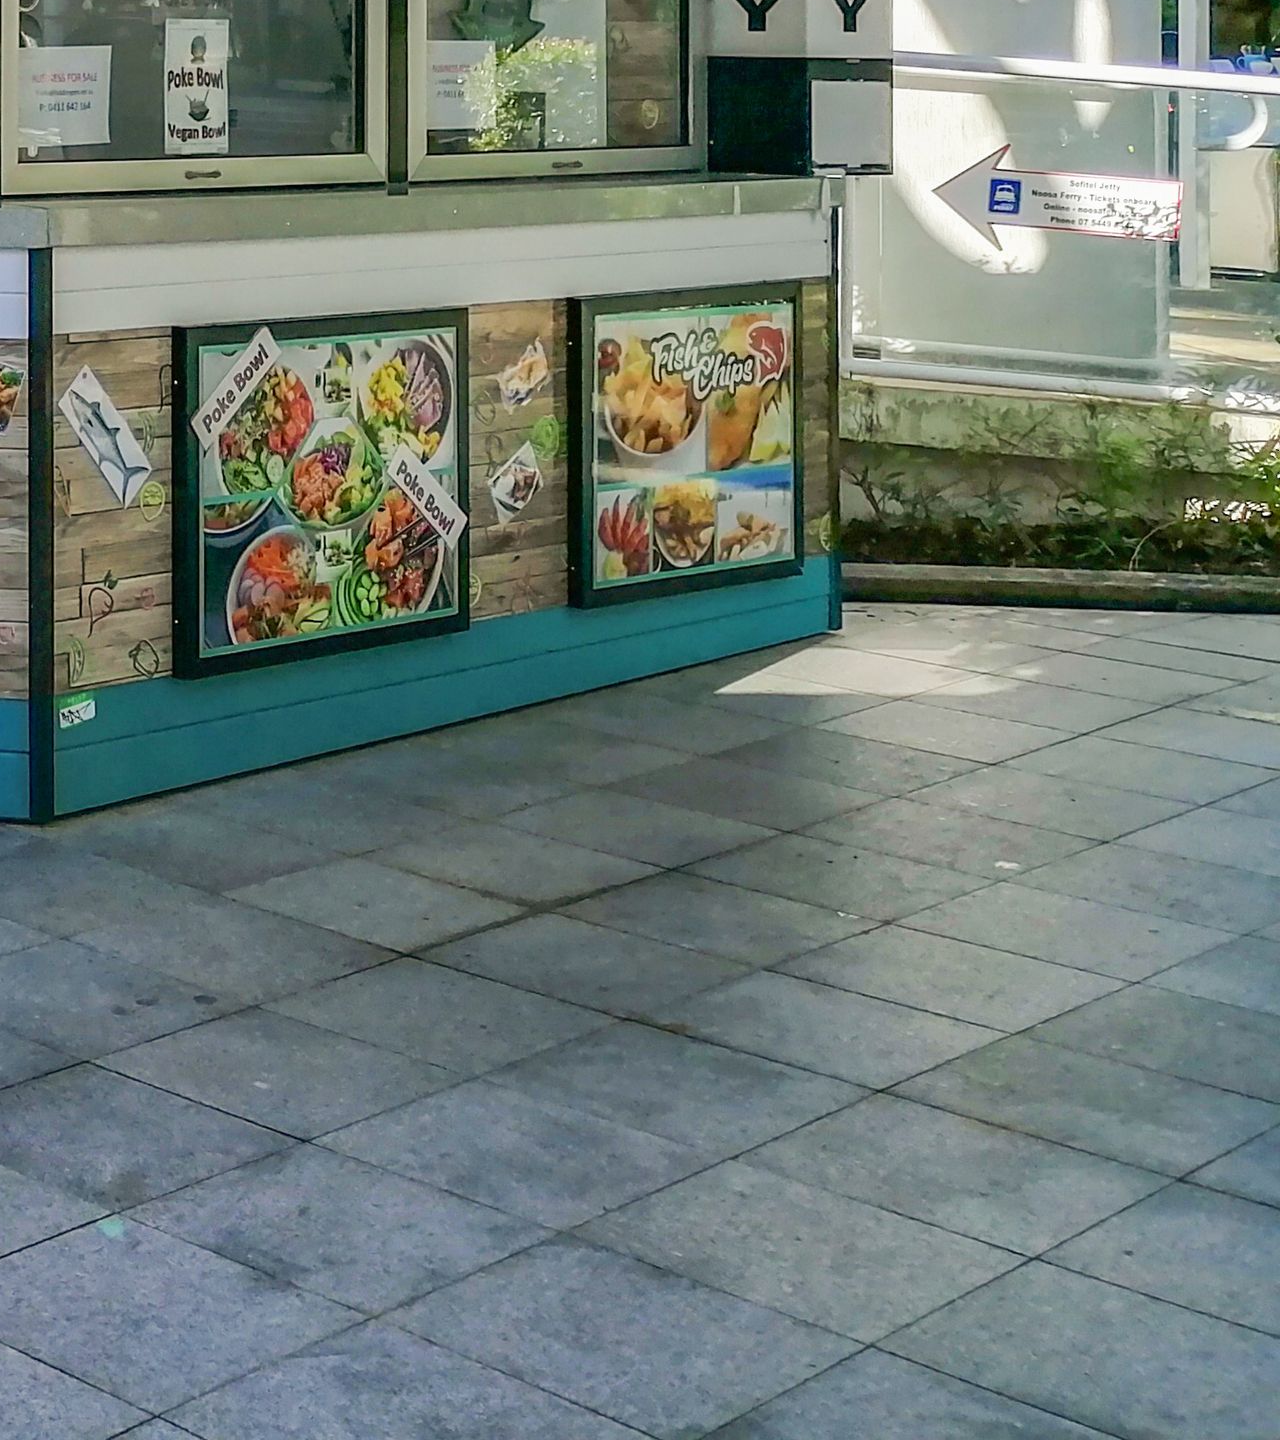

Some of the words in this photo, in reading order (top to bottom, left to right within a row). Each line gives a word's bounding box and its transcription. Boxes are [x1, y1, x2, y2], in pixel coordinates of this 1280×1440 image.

[67, 73, 82, 83] FOR
[82, 72, 98, 82] SALE
[168, 67, 194, 92] Poke
[196, 67, 224, 90] Bowl
[48, 103, 65, 112] 0411
[66, 102, 79, 111] 642
[168, 123, 200, 143] Vegan
[201, 122, 226, 140] Bowl
[1069, 179, 1097, 189] Sofitel
[1100, 181, 1121, 192] Jetty
[1031, 189, 1058, 199] Noosa
[1060, 191, 1081, 202] Ferry
[1090, 194, 1121, 204] Tickets
[1043, 202, 1070, 212] Online
[1050, 216, 1076, 225] Phone
[1078, 217, 1089, 226] 07
[699, 331, 718, 354] &
[650, 333, 698, 384] Fish
[683, 351, 754, 401] Chips
[202, 388, 237, 434] Poke
[233, 342, 269, 393] Bowl
[396, 459, 425, 502] Poke
[424, 493, 456, 536] Bowl
